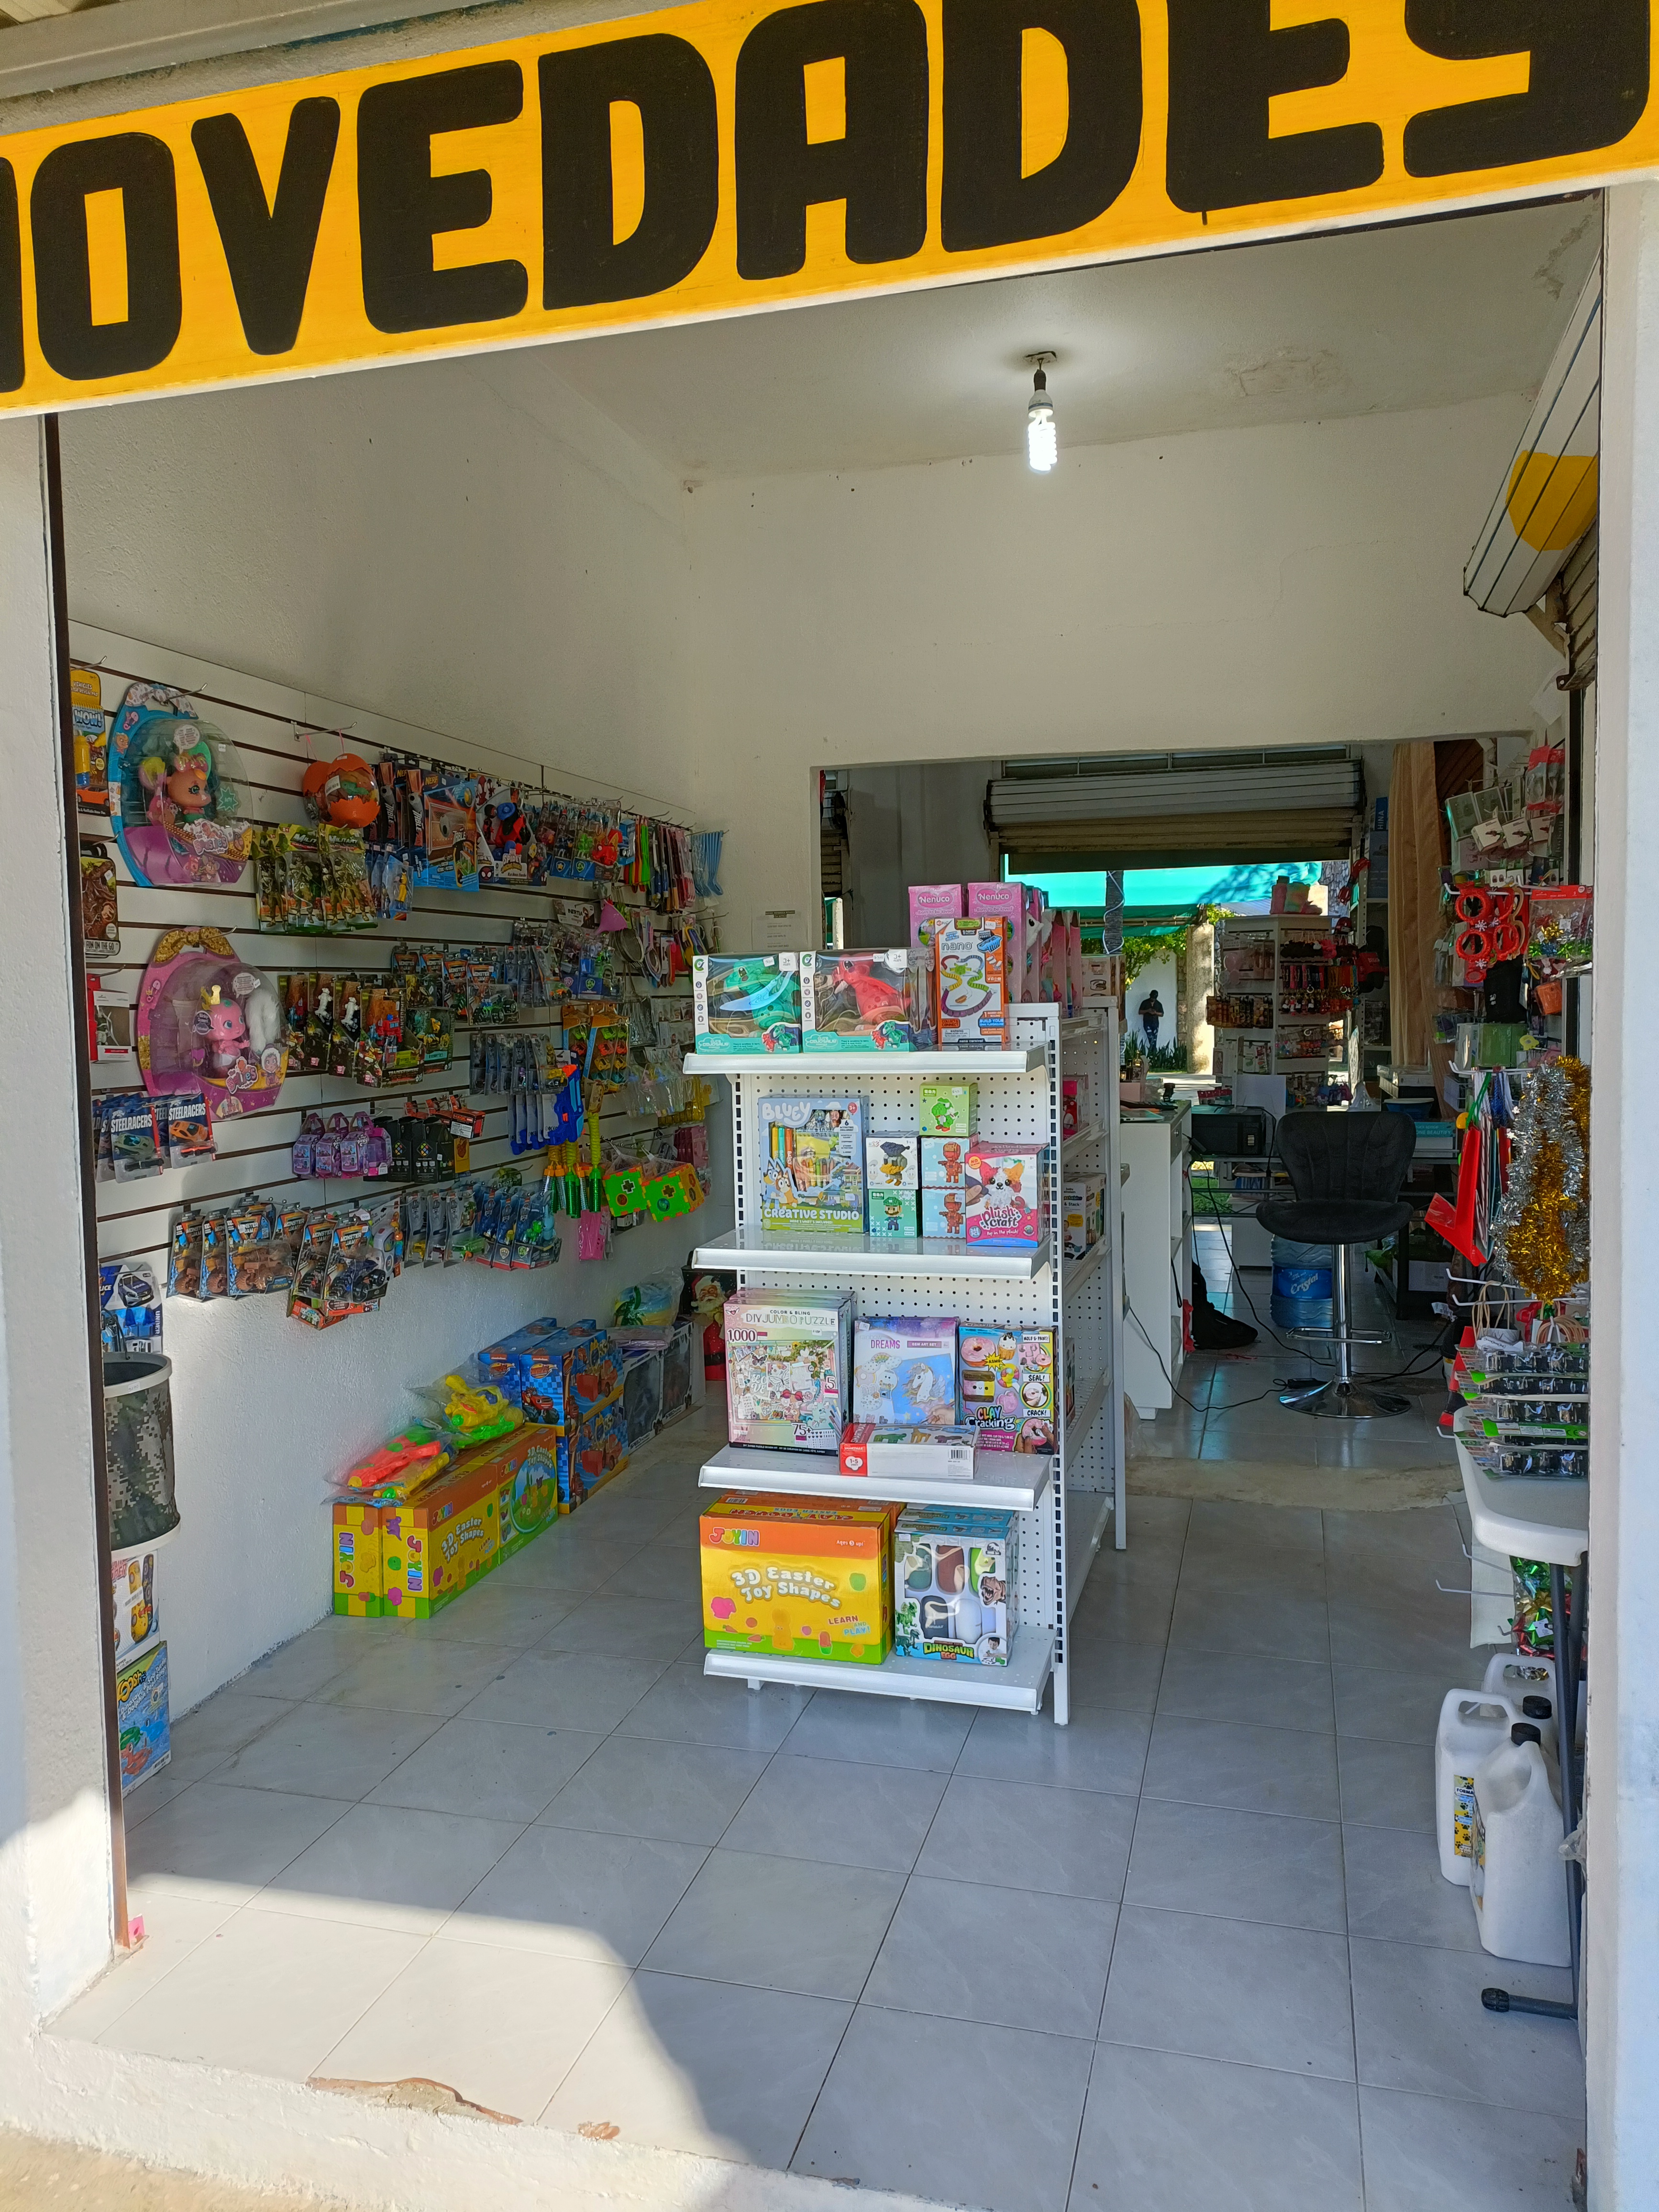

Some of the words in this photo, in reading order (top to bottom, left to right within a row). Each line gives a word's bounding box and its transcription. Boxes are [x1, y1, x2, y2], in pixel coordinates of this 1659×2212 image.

[0, 0, 1649, 392] OVEDADES
[73, 681, 92, 690] VEHICLES
[74, 709, 102, 728] WOW!
[425, 775, 439, 785] NERF
[412, 809, 423, 832] TABLE
[293, 833, 317, 843] MILIT
[329, 834, 358, 844] MILITARY
[503, 855, 521, 865] SPIDEY
[918, 895, 950, 904] Nenuco
[978, 892, 1009, 900] Nenuco
[86, 940, 94, 949] FUN
[95, 941, 100, 950] ON
[109, 942, 114, 951] GO
[941, 942, 973, 951] nano
[168, 1103, 206, 1121] STEELRACERS
[762, 1101, 810, 1126] BLUEY
[111, 1114, 152, 1133] STEELRACERS
[819, 1210, 859, 1220] STUDIO
[284, 1218, 304, 1227] MONSTER
[990, 1217, 1018, 1227] craft
[312, 1229, 333, 1239] MONSTER
[340, 1233, 362, 1242] MONSTER
[1291, 1272, 1318, 1294] Cristal
[746, 1314, 762, 1322] DIY
[762, 1314, 797, 1324] JUMBO
[799, 1316, 835, 1326] PUZZLE
[728, 1329, 756, 1342] 1,000
[871, 1339, 900, 1349] DREAMS
[826, 1377, 835, 1389] 5
[977, 1406, 1002, 1419] CLAY
[966, 1416, 1015, 1429] Cracking
[792, 1424, 811, 1435] 75+
[528, 1447, 536, 1457] 3D
[536, 1445, 553, 1458] Easter
[500, 1458, 517, 1477] JOYIN
[528, 1456, 536, 1466] Toy
[537, 1454, 553, 1469] Shapes
[431, 1501, 453, 1526] JOYIN
[442, 1532, 454, 1552] 3D
[456, 1517, 482, 1534] Easter
[709, 1527, 760, 1547] JOYIN
[445, 1542, 458, 1562] Toy
[460, 1529, 484, 1544] Shapes
[479, 1537, 491, 1552] LEARN
[339, 1532, 354, 1588] JOYIN
[407, 1535, 422, 1592] JOYIN
[731, 1569, 761, 1586] 3D
[767, 1567, 835, 1589] Easter
[741, 1585, 772, 1602] Toy
[779, 1582, 841, 1608] Shapes
[828, 1615, 859, 1625] LEARN
[844, 1626, 871, 1635] PLAY!
[923, 1642, 974, 1659] DINOSAUR
[940, 1651, 957, 1660] EGG
[121, 1689, 143, 1714] Dinosaur
[156, 1658, 166, 1673] Turtle
[128, 1692, 146, 1714] Dolphin
[146, 1681, 155, 1693] Pool
